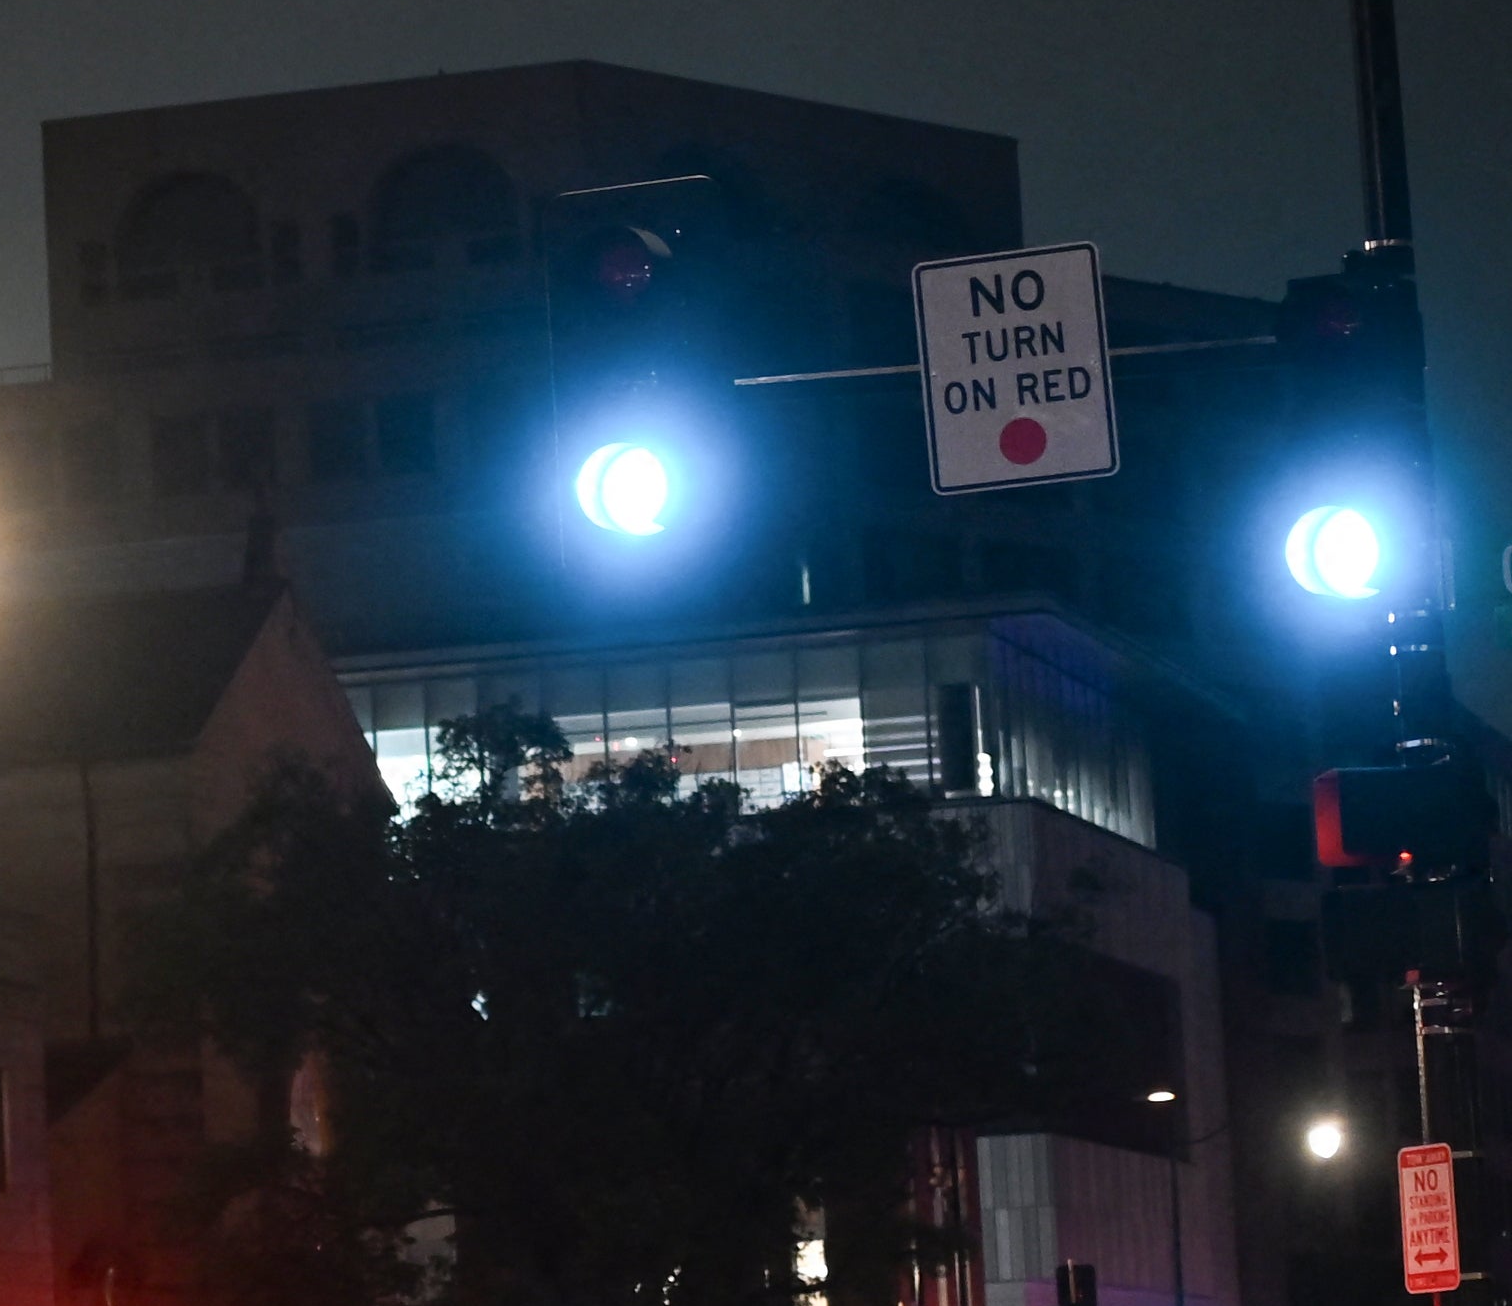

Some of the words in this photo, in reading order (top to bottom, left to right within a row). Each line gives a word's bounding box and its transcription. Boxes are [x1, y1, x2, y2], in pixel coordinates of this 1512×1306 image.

[968, 268, 1045, 317] NO
[961, 321, 1066, 366] TURN
[943, 379, 997, 414] ON
[1017, 367, 1092, 406] RED
[1414, 1170, 1438, 1192] NO
[1409, 1193, 1447, 1209] STANDING
[1419, 1209, 1450, 1226] PARKING
[1410, 1226, 1450, 1247] ANYTIME
